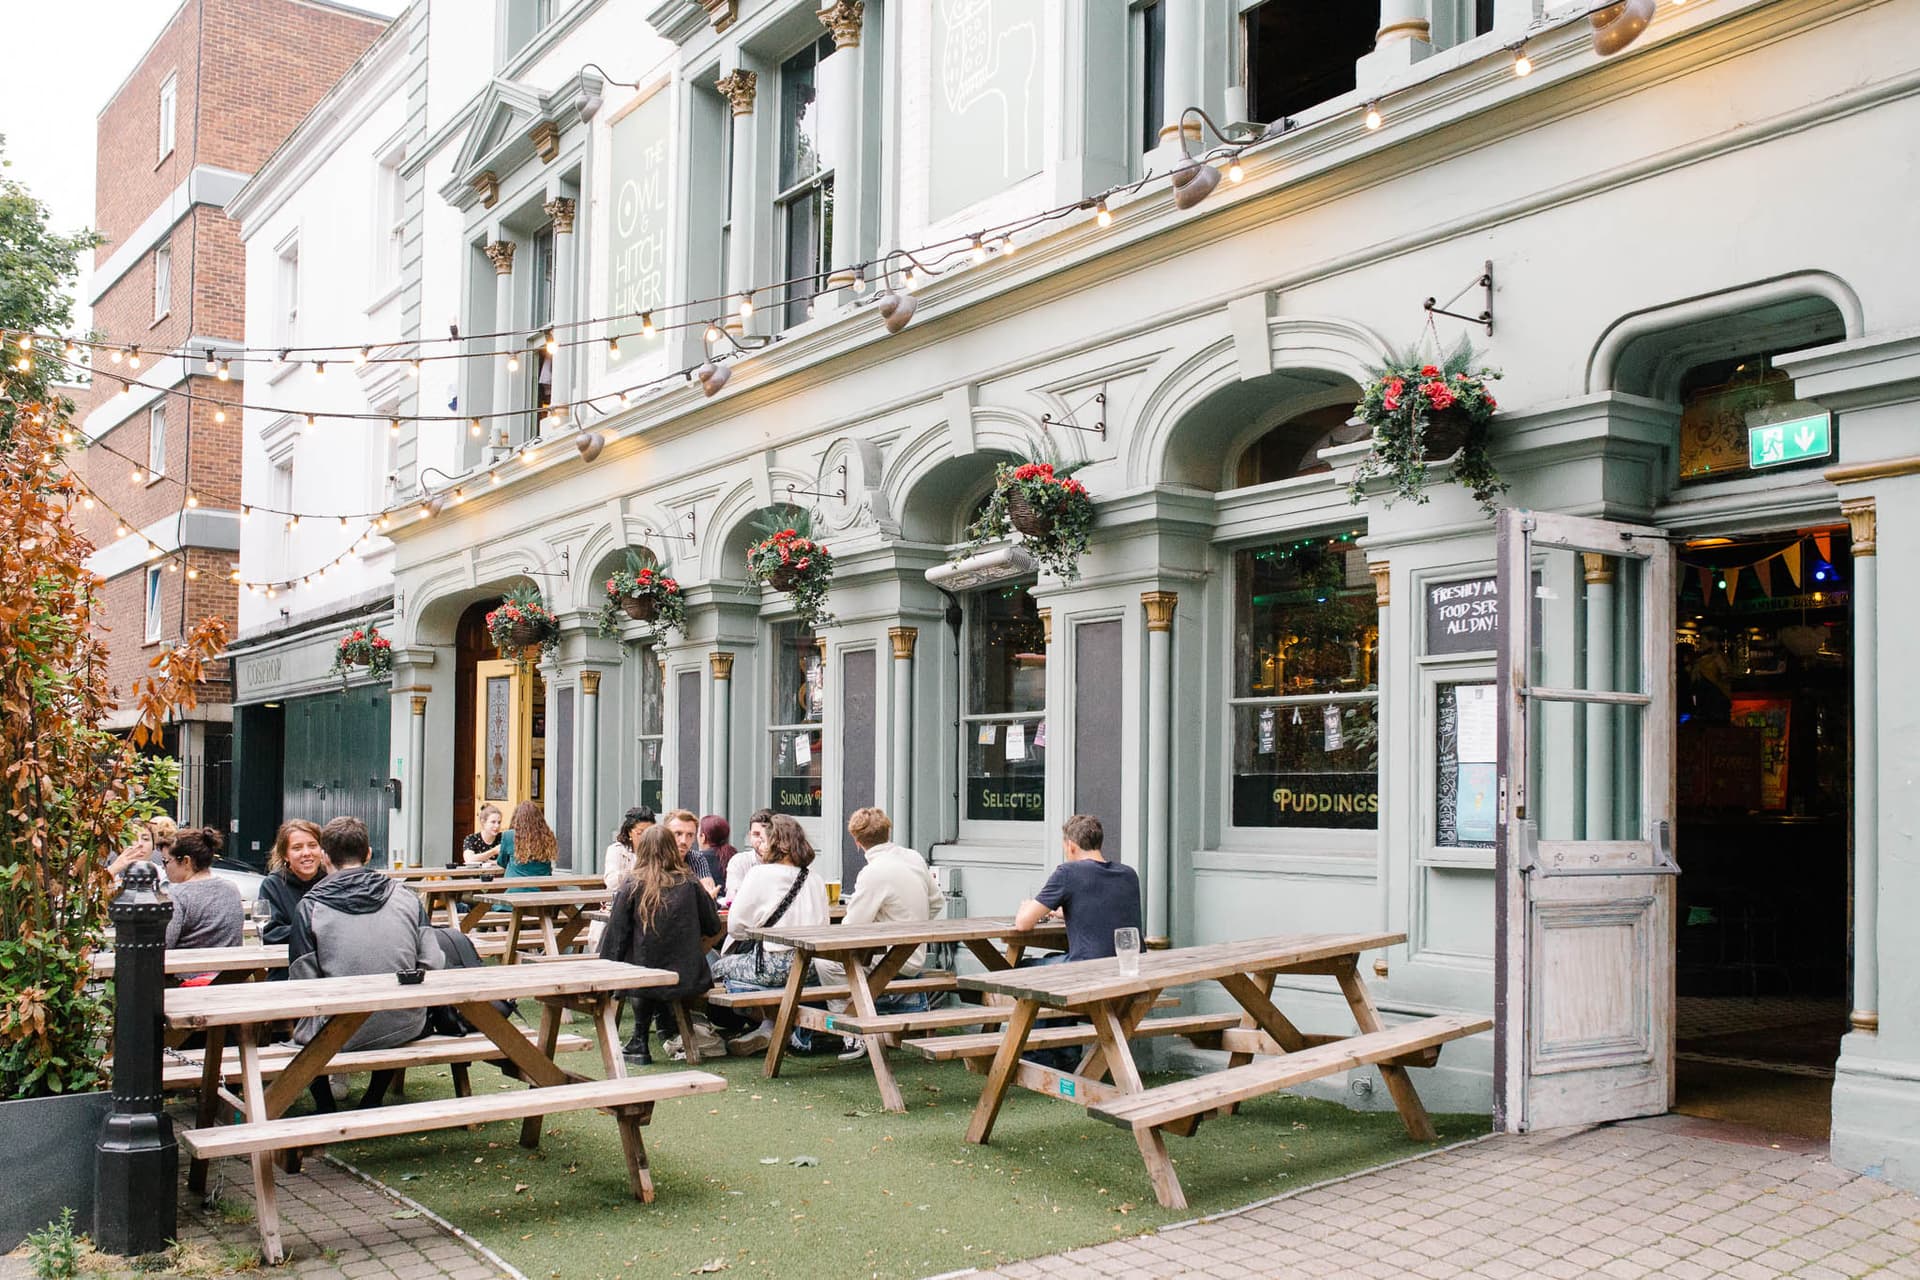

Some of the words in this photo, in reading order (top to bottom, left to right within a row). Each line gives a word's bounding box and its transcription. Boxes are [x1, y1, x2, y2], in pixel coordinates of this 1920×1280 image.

[644, 139, 665, 170] THE
[617, 171, 665, 239] OWL
[640, 214, 649, 233] &
[615, 228, 664, 289] HITCH
[614, 271, 662, 326] HIKER
[1431, 581, 1481, 605] FRESHLY
[1439, 602, 1471, 621] FOOD
[1447, 619, 1469, 635] ALL
[1468, 614, 1498, 633] DAY!
[247, 657, 282, 687] COSPROP
[780, 789, 813, 806] SUNDAY
[982, 788, 1042, 809] SELECTED
[1272, 788, 1379, 813] PUDDINGS
